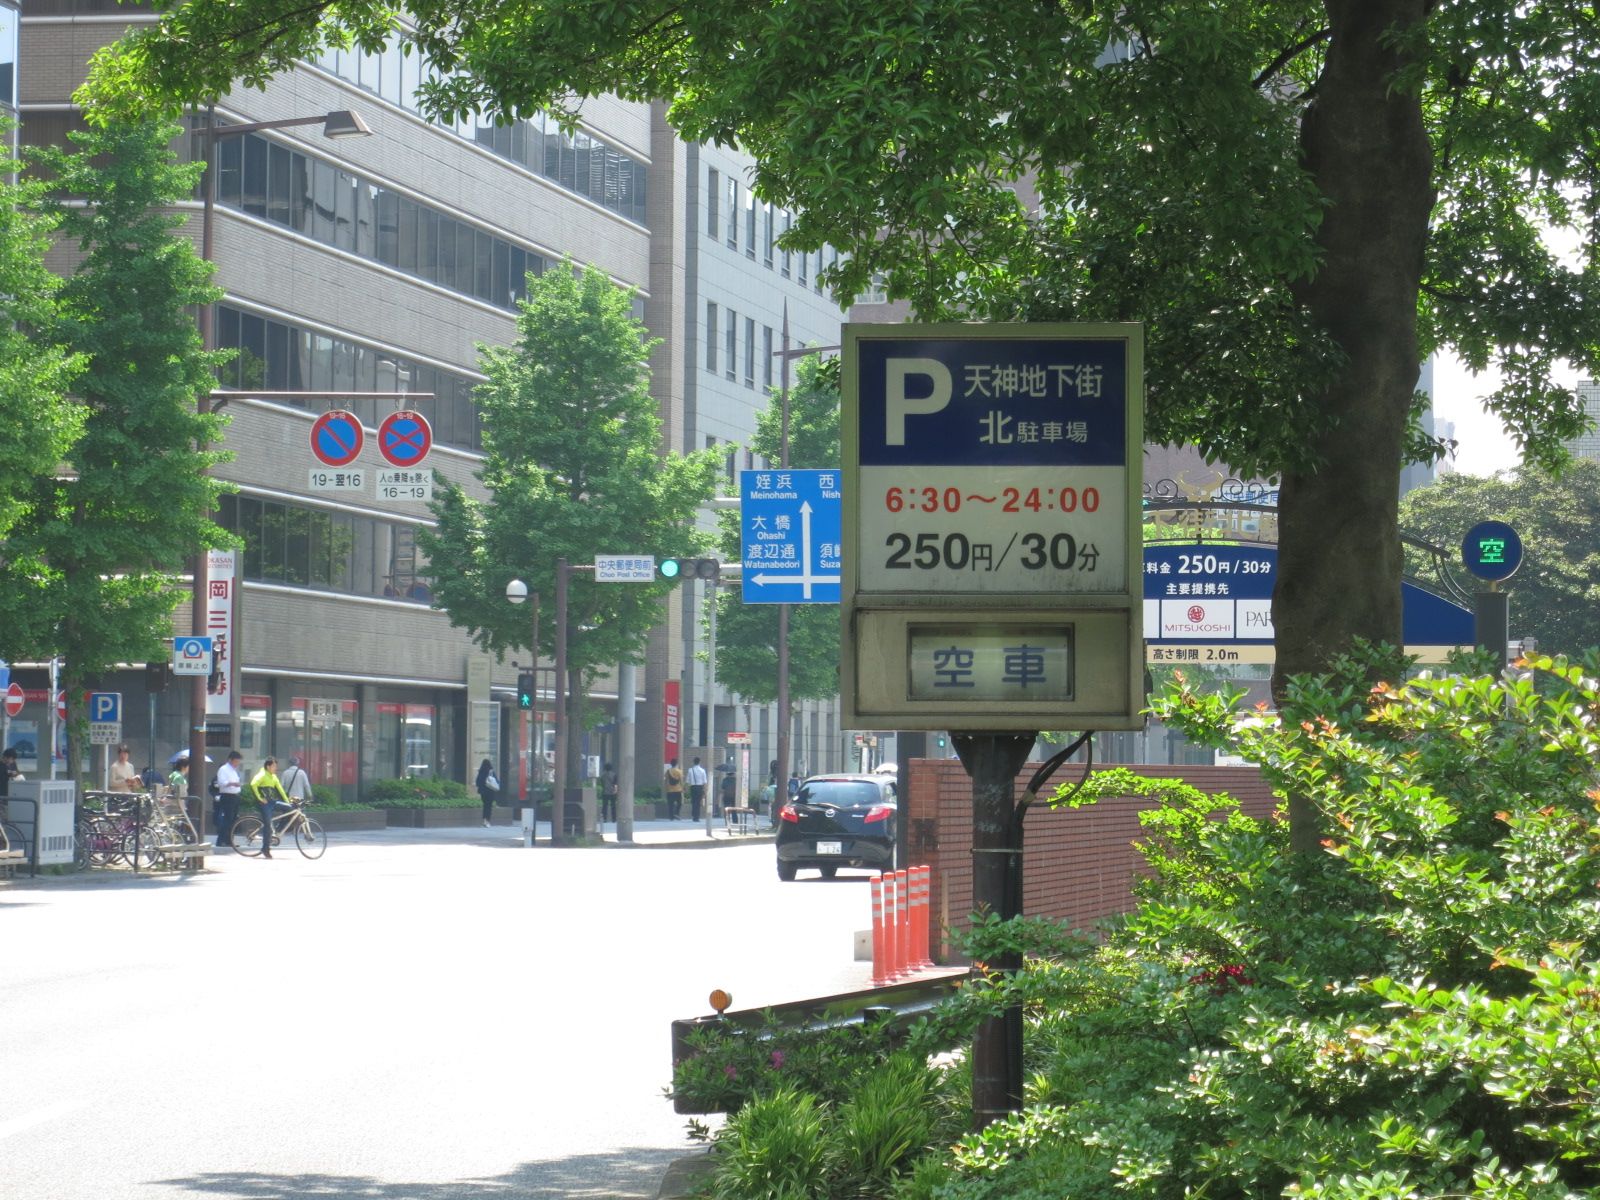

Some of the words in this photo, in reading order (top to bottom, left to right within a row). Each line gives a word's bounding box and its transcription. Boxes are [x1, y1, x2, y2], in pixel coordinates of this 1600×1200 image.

[964, 365, 1103, 398] 天神地下街
[886, 358, 953, 445] P
[979, 411, 1088, 444] 北駐車場
[756, 474, 792, 489] 姪浜
[750, 491, 797, 499] Meinohama
[752, 515, 791, 530] 大橋
[757, 531, 786, 540] Ohashi
[748, 544, 795, 559] 渡辺通
[1480, 539, 1504, 562] 空
[744, 561, 800, 569] Watanabedori
[1143, 561, 1171, 574] 料金
[1166, 583, 1229, 595] 主要提携先
[1165, 624, 1231, 632] MITSUKOSHI
[1153, 649, 1199, 660] 高さ制限
[1206, 649, 1239, 660] 2.0m
[933, 644, 1047, 688] 空車
[97, 696, 113, 720] P
